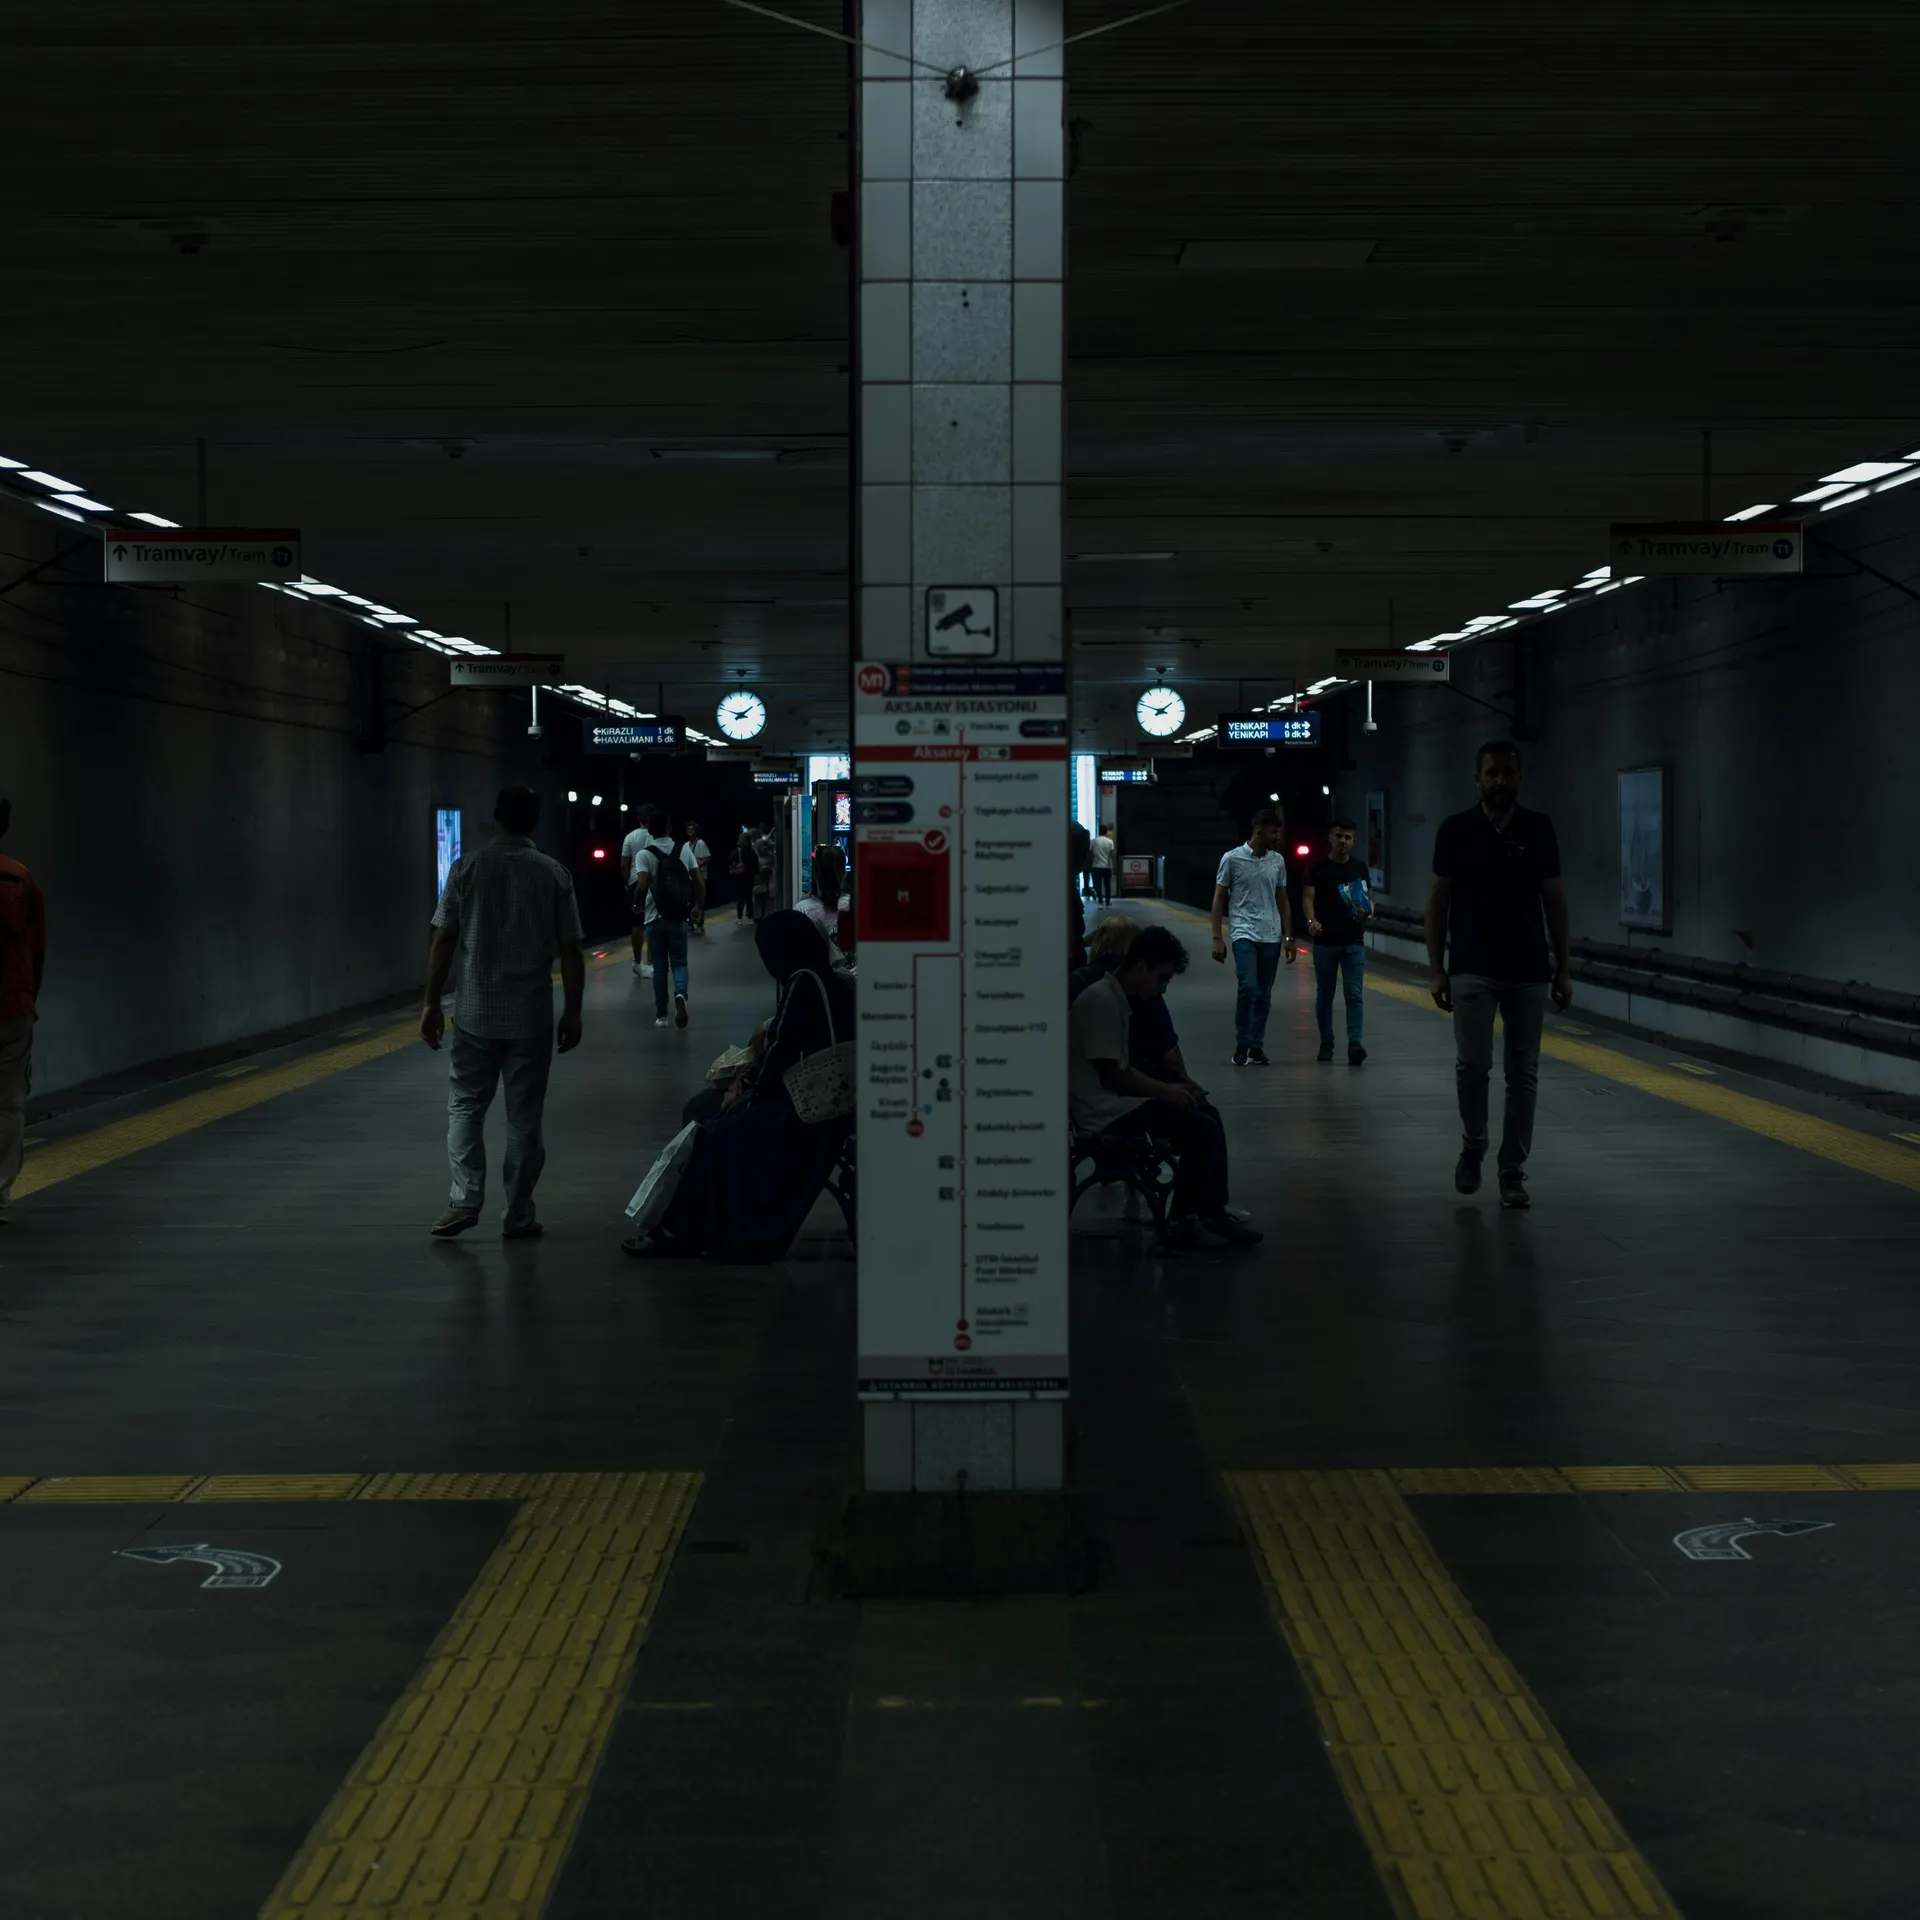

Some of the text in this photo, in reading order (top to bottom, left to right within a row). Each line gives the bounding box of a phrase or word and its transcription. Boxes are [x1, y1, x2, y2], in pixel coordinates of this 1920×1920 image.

[860, 674, 884, 687] M1
[884, 699, 1037, 713] AKSARAY İSTASYONU
[1284, 721, 1290, 730] 4
[1291, 721, 1302, 730] dk
[663, 727, 675, 735] dk
[1284, 730, 1290, 739] 9
[1291, 730, 1302, 739] dk
[657, 735, 663, 743] 5
[663, 735, 675, 743] dk
[913, 747, 971, 760] Aksaray
